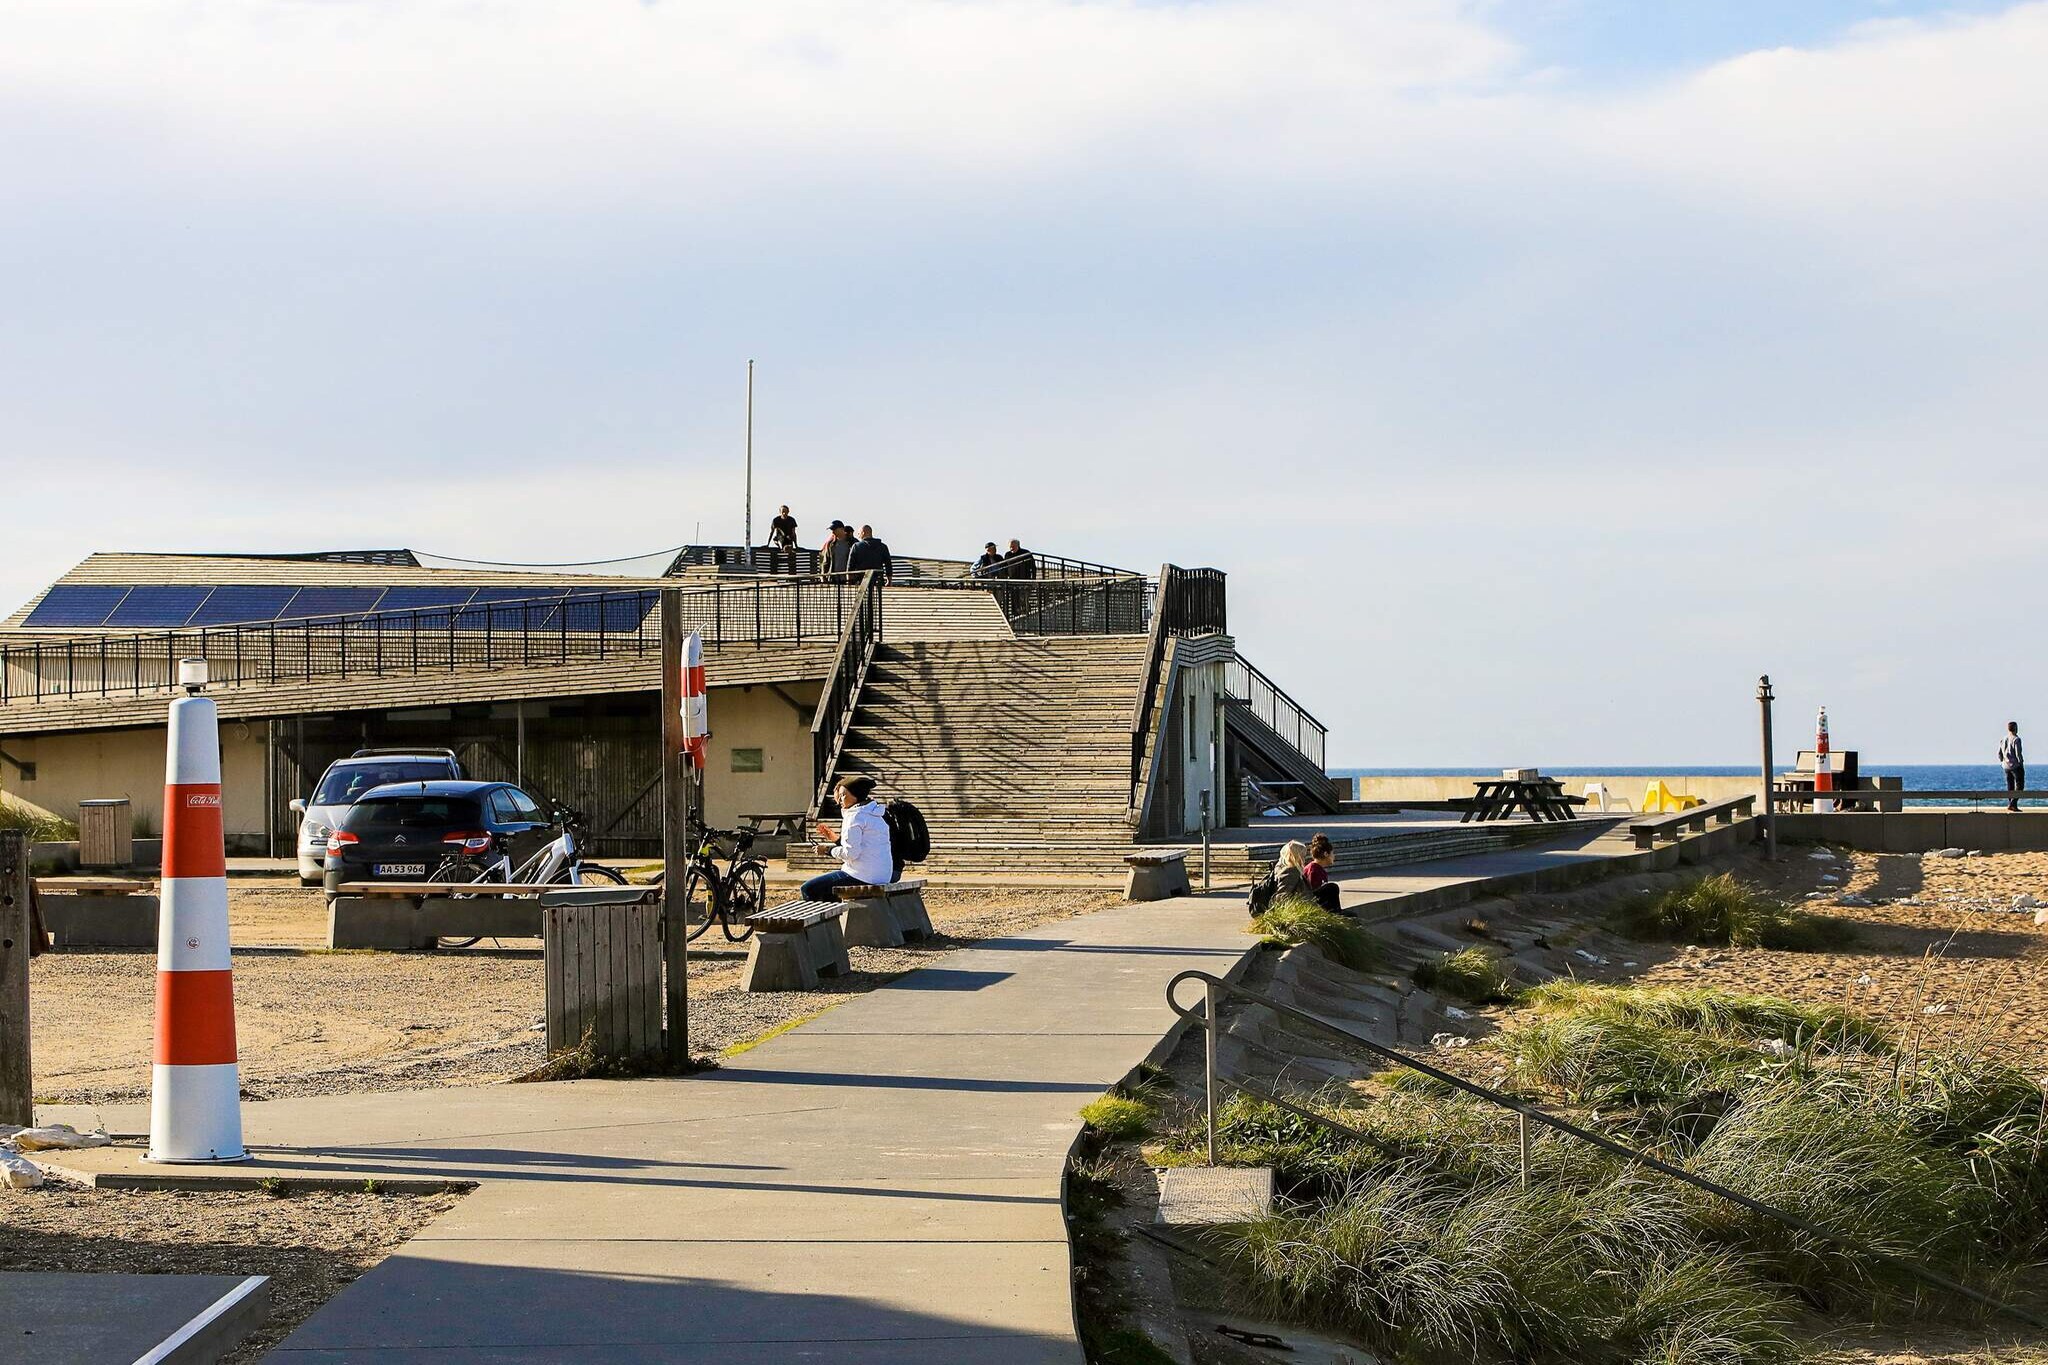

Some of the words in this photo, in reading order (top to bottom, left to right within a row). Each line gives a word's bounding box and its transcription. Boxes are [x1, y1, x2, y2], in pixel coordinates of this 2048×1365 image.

[380, 865, 392, 873] AA
[394, 865, 405, 873] 53
[407, 865, 424, 873] 964
